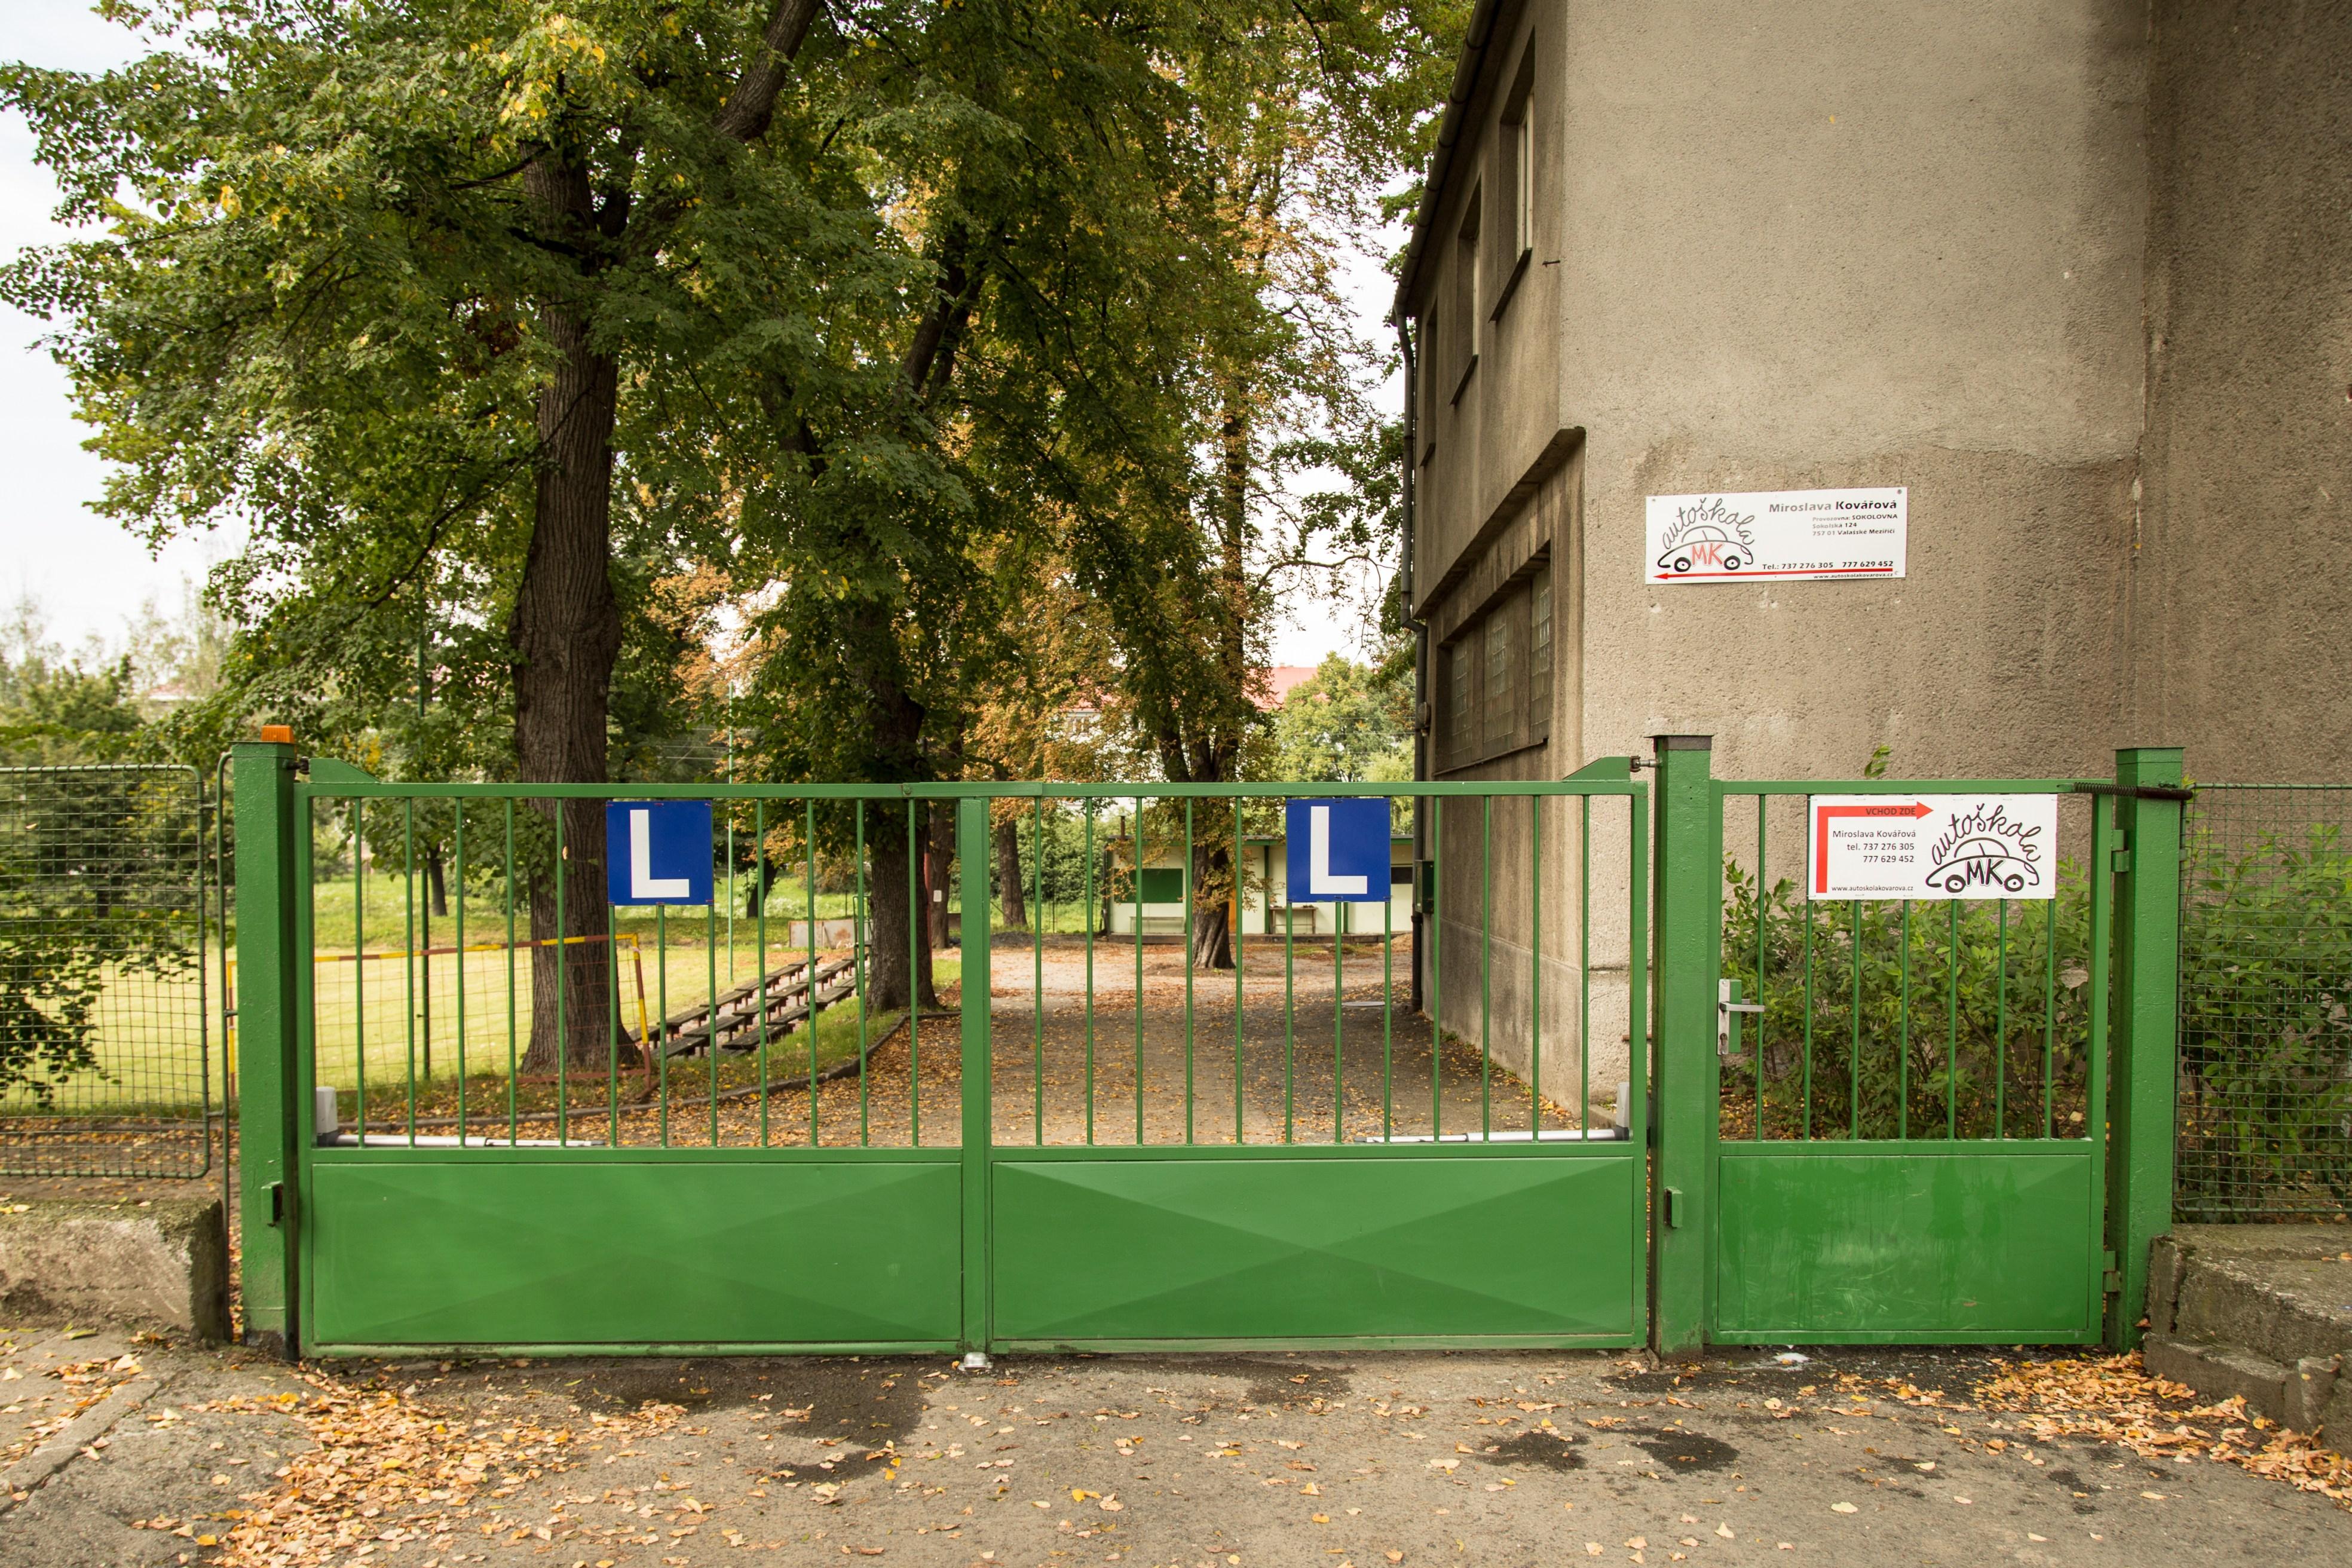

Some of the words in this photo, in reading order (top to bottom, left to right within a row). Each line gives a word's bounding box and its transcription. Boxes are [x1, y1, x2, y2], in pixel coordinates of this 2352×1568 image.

[1769, 503, 1832, 513] Miroslava
[1836, 500, 1897, 510] Kovářová
[1662, 498, 1755, 550] autoškola
[1690, 543, 1725, 566] MK
[1899, 807, 1916, 815] ZDE
[1876, 829, 1916, 838] Kovářová
[1931, 803, 2041, 865] autoškola
[630, 809, 690, 898] L
[1310, 806, 1368, 894] L
[1966, 858, 2004, 886] MK
